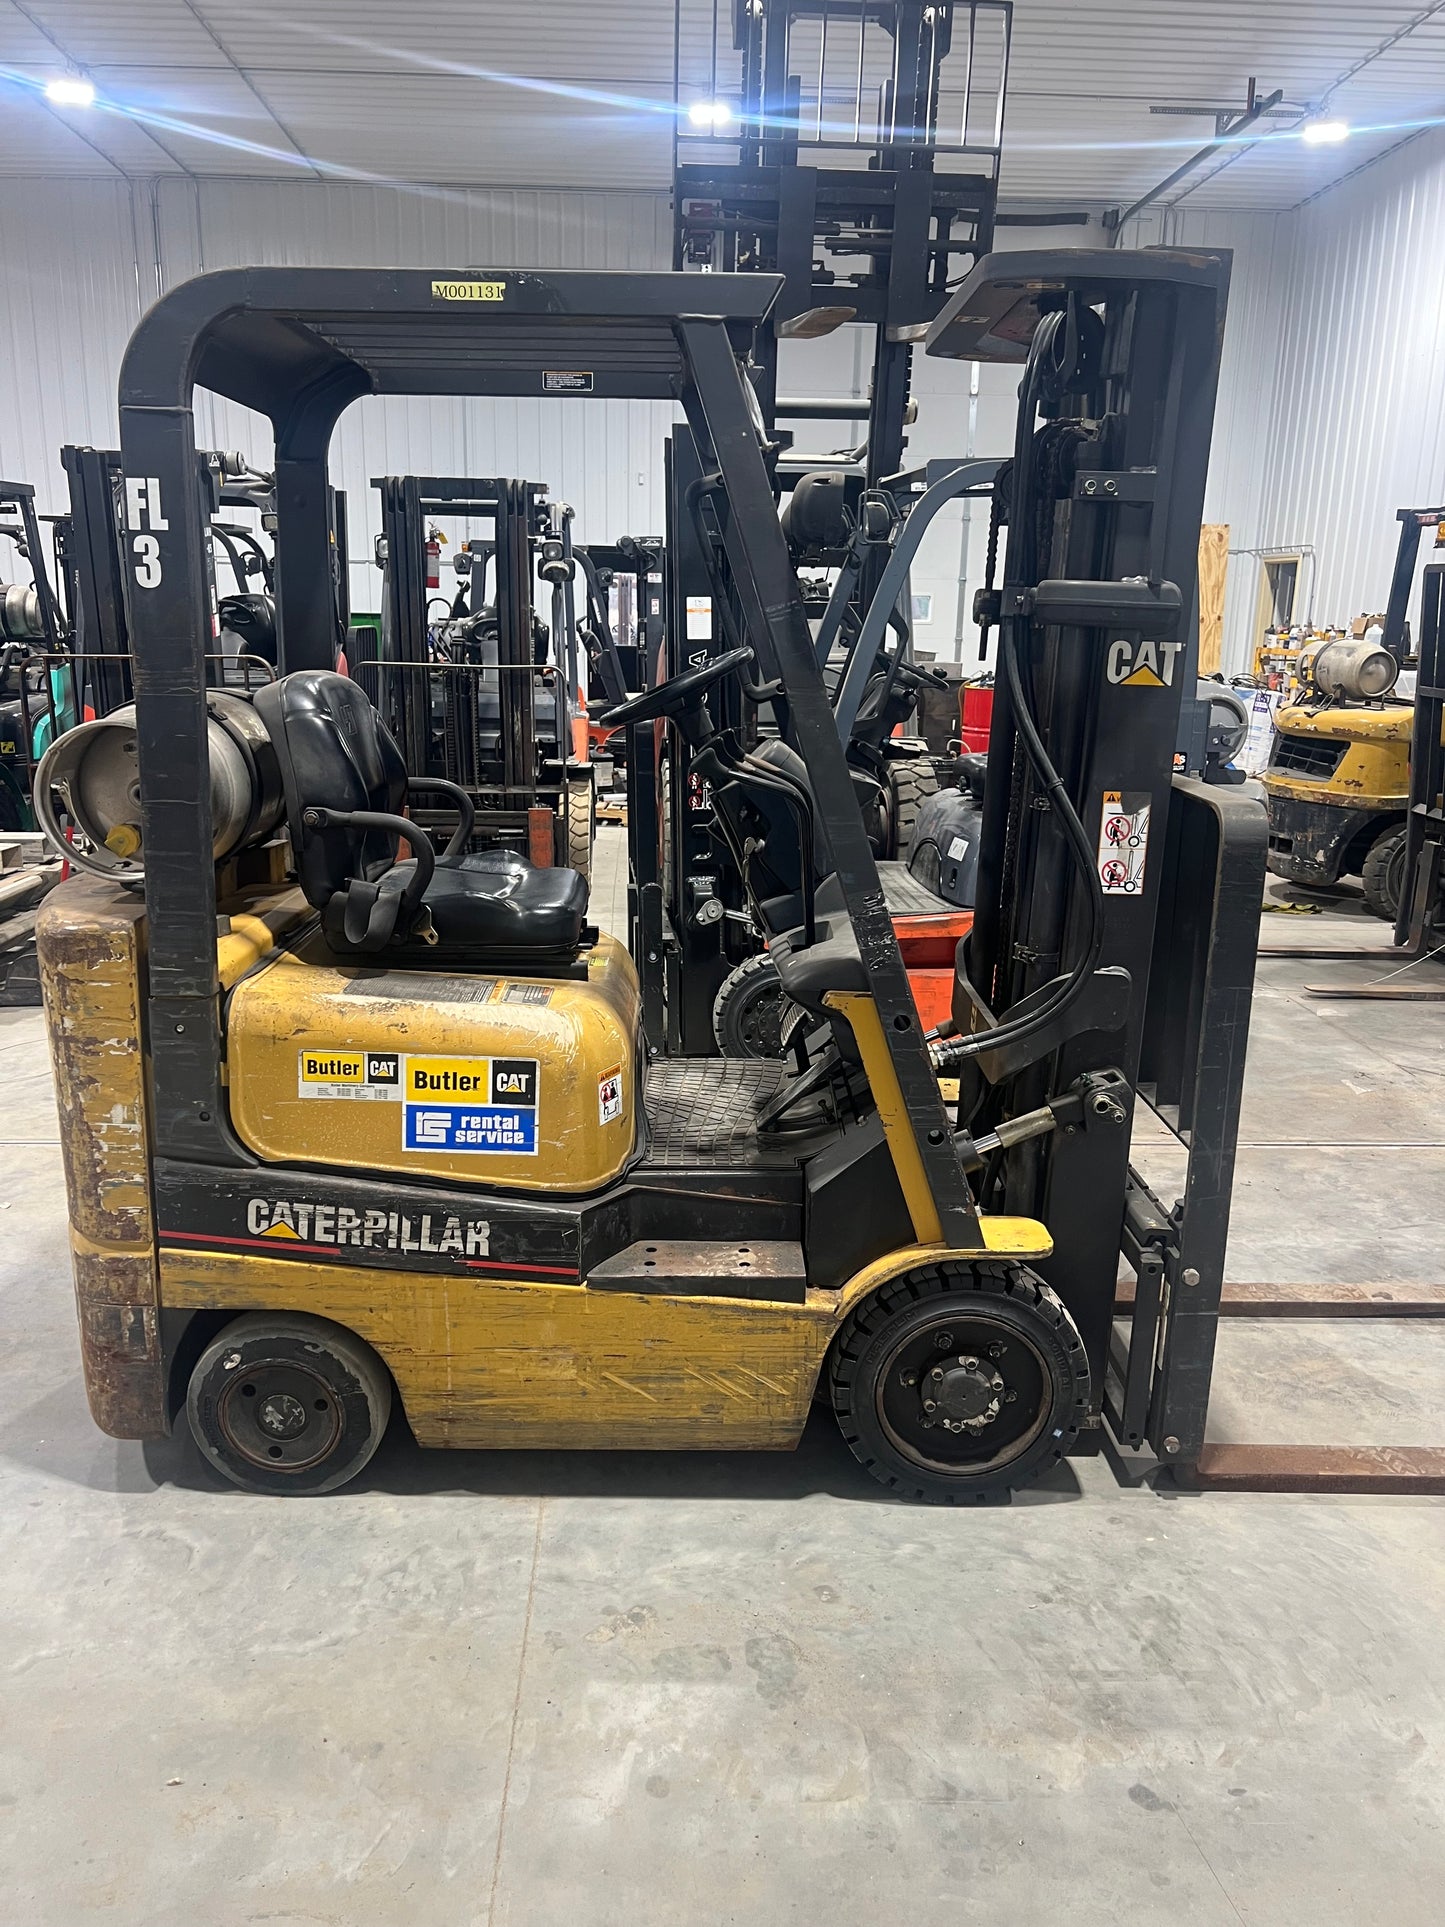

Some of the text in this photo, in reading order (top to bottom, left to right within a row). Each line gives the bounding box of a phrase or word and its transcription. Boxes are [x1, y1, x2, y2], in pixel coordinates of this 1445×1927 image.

[435, 285, 502, 299] M001131
[125, 477, 169, 531] FL
[133, 534, 163, 589] 3
[1106, 640, 1182, 687] CAT
[307, 1059, 360, 1076] Butler
[370, 1060, 396, 1077] CAT
[414, 1070, 481, 1092] Butler
[496, 1072, 529, 1093] CAT
[461, 1115, 520, 1130] rental
[455, 1128, 525, 1144] service
[247, 1198, 491, 1257] CATERPILLAR
